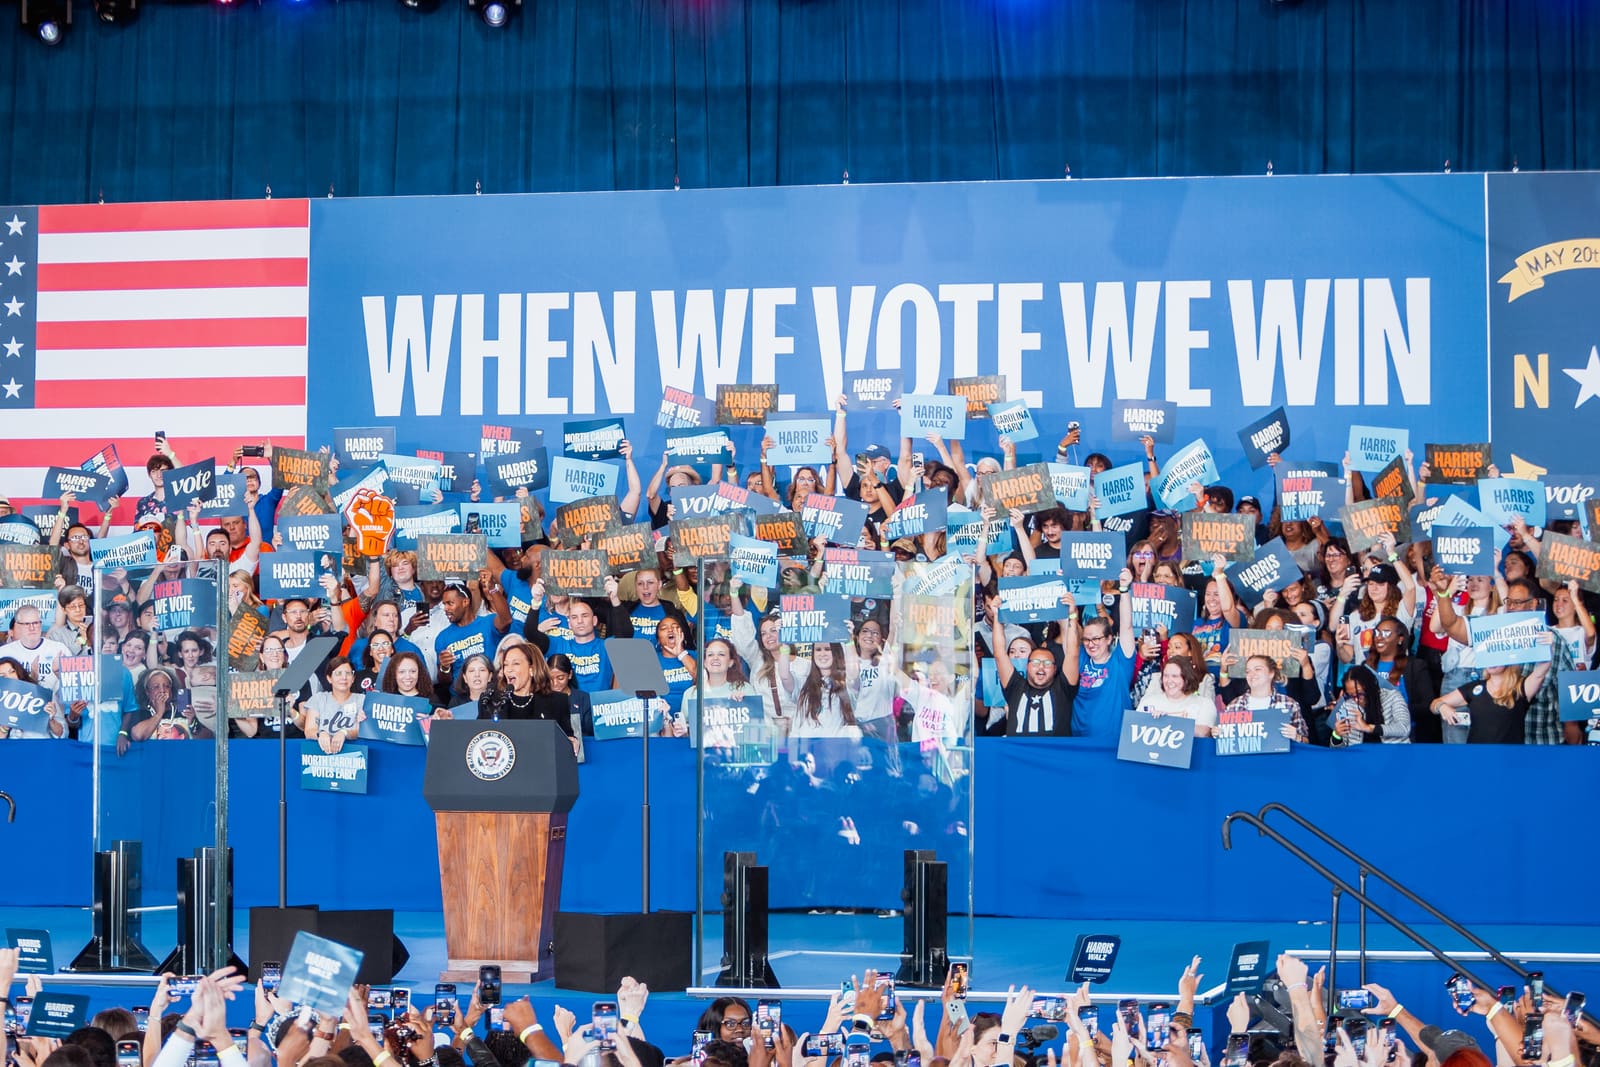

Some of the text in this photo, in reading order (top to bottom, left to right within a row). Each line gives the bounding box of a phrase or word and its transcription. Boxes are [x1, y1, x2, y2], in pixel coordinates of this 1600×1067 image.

[1525, 247, 1564, 276] MAY
[362, 277, 1430, 416] WHEN WE VOTE WE WIN
[853, 377, 893, 393] HARRIS
[1514, 352, 1549, 409] N
[664, 387, 694, 407] WHEN
[724, 392, 771, 409] HARRIS
[859, 390, 885, 401] WALZ
[955, 383, 998, 403] HARRIS
[660, 400, 701, 426] WE VOTE,
[730, 407, 764, 420] WALZ
[913, 405, 953, 421] HARRIS
[995, 410, 1030, 427] CAROLINA
[1123, 408, 1165, 425] HARRIS
[482, 424, 512, 441] WHEN
[919, 419, 947, 430] WALZ
[1004, 420, 1024, 435] EARLY
[1129, 422, 1158, 434] WALZ
[778, 430, 819, 447] HARRIS
[1250, 420, 1284, 450] HARRIS
[345, 437, 384, 453] HARRIS
[481, 438, 497, 455] WE
[574, 442, 596, 453] VOTES
[676, 446, 701, 456] VOTES
[785, 443, 814, 455] WALZ
[1261, 437, 1283, 455] WALZ
[1360, 437, 1397, 455] HARRIS
[350, 451, 379, 461] WALZ
[1174, 449, 1210, 479] CAROLINA
[1365, 451, 1391, 464] WALZ
[1434, 451, 1483, 469] HARRIS
[278, 455, 321, 477] HARRIS
[498, 459, 538, 480] HARRIS
[1441, 467, 1476, 479] WALZ
[56, 472, 97, 488] HARRIS
[170, 469, 212, 498] vote
[283, 472, 314, 486] WALZ
[404, 468, 439, 482] CAROLINA
[506, 475, 534, 488] WALZ
[565, 468, 605, 488] HARRIS
[1166, 462, 1207, 494] VOTES EARLY
[1376, 467, 1403, 494] HARRIS
[60, 484, 88, 494] WALZ
[570, 484, 598, 496] WALZ
[719, 483, 749, 504] WHEN
[991, 473, 1043, 500] HARRIS
[1055, 488, 1077, 499] EARLY
[1102, 476, 1135, 497] HARRIS
[1282, 478, 1313, 492] WHEN
[1545, 482, 1595, 504] vote
[807, 494, 837, 511] WHEN
[1002, 491, 1038, 509] WALZ
[1108, 492, 1132, 506] WALZ
[1282, 491, 1325, 510] WE VOTE,
[1494, 489, 1535, 506] HARRIS
[564, 503, 612, 528] HARRIS
[903, 504, 928, 520] VOTE,
[1283, 505, 1320, 522] WE WIN
[1350, 504, 1402, 530] HARRIS
[1502, 503, 1530, 514] WALZ
[801, 507, 843, 530] WE VOTE,
[289, 525, 330, 542] HARRIS
[572, 521, 607, 537] WALZ
[679, 525, 731, 546] HARRIS
[905, 519, 924, 536] WIN
[948, 525, 970, 536] NORTH
[1191, 521, 1245, 542] HARRIS
[296, 539, 325, 550] WALZ
[955, 534, 977, 546] VOTES
[1200, 541, 1238, 553] WALZ
[1437, 537, 1481, 555] HARRIS
[92, 549, 119, 562] NORTH
[119, 541, 155, 558] CAROLINA
[427, 543, 477, 562] HARRIS
[607, 551, 642, 567] WALZ
[689, 543, 725, 558] WALZ
[738, 551, 776, 567] CAROLINA
[825, 549, 858, 565] WHEN
[1071, 543, 1112, 561] HARRIS
[1442, 552, 1474, 565] WALZ
[1549, 542, 1600, 572] HARRIS
[5, 552, 52, 570] HARRIS
[104, 553, 148, 568] VOTES EARLY
[434, 561, 470, 573] WALZ
[549, 559, 600, 578] HARRIS
[742, 562, 766, 575] EARLY
[1076, 559, 1107, 570] WALZ
[13, 567, 46, 582] WALZ
[273, 562, 315, 580] HARRIS
[826, 564, 873, 584] WE VOTE,
[1238, 553, 1281, 588] HARRIS
[1554, 563, 1591, 581] WALZ
[155, 580, 182, 595] WHEN
[279, 578, 311, 589] WALZ
[557, 576, 593, 589] WALZ
[845, 580, 867, 596] WIN
[1251, 571, 1281, 593] WALZ
[1133, 584, 1165, 600] WHEN
[155, 595, 196, 614] WE VOTE,
[782, 595, 815, 611] WHEN
[1009, 599, 1033, 612] VOTES
[1132, 597, 1178, 619] WE VOTE,
[172, 611, 191, 628] WIN
[781, 610, 829, 629] WE VOTE,
[909, 604, 959, 625] HARRIS
[1132, 611, 1150, 628] WE
[228, 612, 258, 659] HARRIS
[781, 626, 822, 642] WE WIN
[1473, 624, 1546, 643] NORTH CAROLINA
[1239, 638, 1293, 657] HARRIS
[1485, 637, 1537, 654] VOTES EARLY
[60, 656, 93, 672] WHEN
[575, 664, 600, 676] HARRIS
[61, 671, 79, 688] WE
[62, 686, 79, 703] WE
[239, 698, 274, 711] WALZ
[372, 703, 413, 724] HARRIS
[604, 713, 632, 726] VOTES
[704, 706, 750, 726] HARRIS
[1219, 711, 1253, 725] WHEN
[378, 719, 406, 733] WALZ
[1218, 721, 1268, 740] WE VOTE,
[1131, 723, 1185, 750] vote
[1217, 738, 1262, 754] WE WIN
[312, 767, 357, 780] VOTES EARLY
[1086, 941, 1114, 955] HARRIS
[1088, 953, 1107, 961] WALZ
